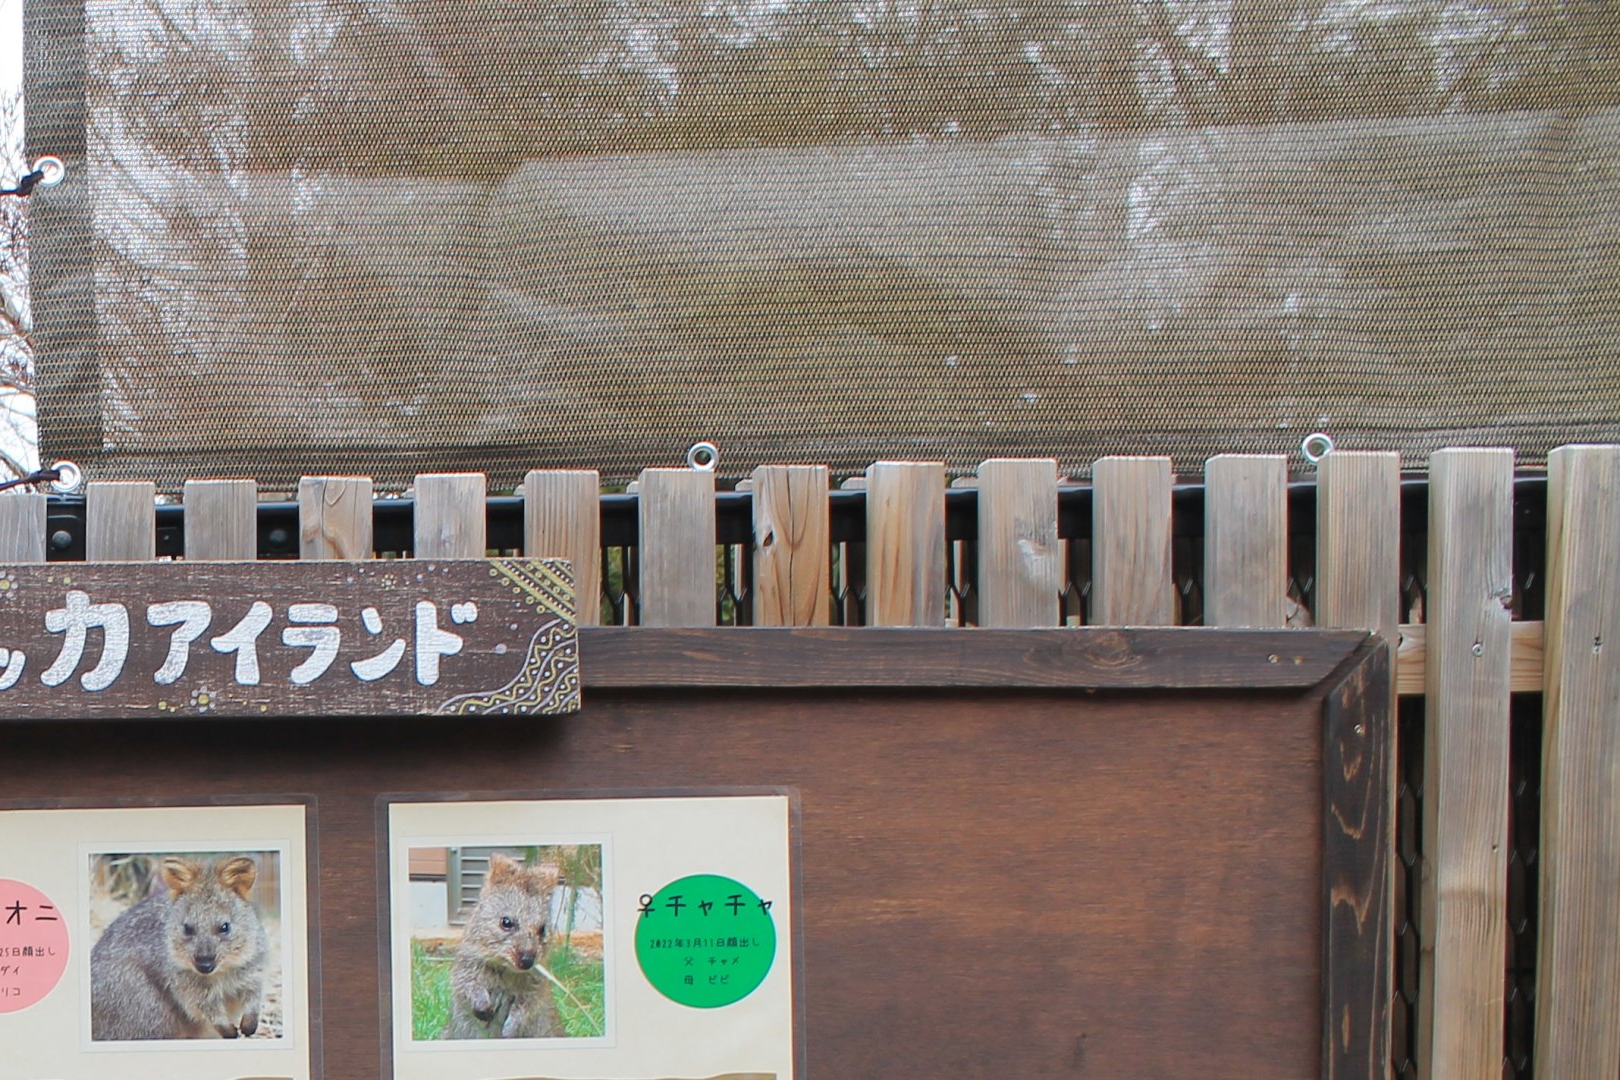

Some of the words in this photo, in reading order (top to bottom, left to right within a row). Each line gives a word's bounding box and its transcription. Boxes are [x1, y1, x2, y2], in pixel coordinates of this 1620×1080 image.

[665, 893, 772, 917] チャチャ
[1, 987, 21, 997] リコ
